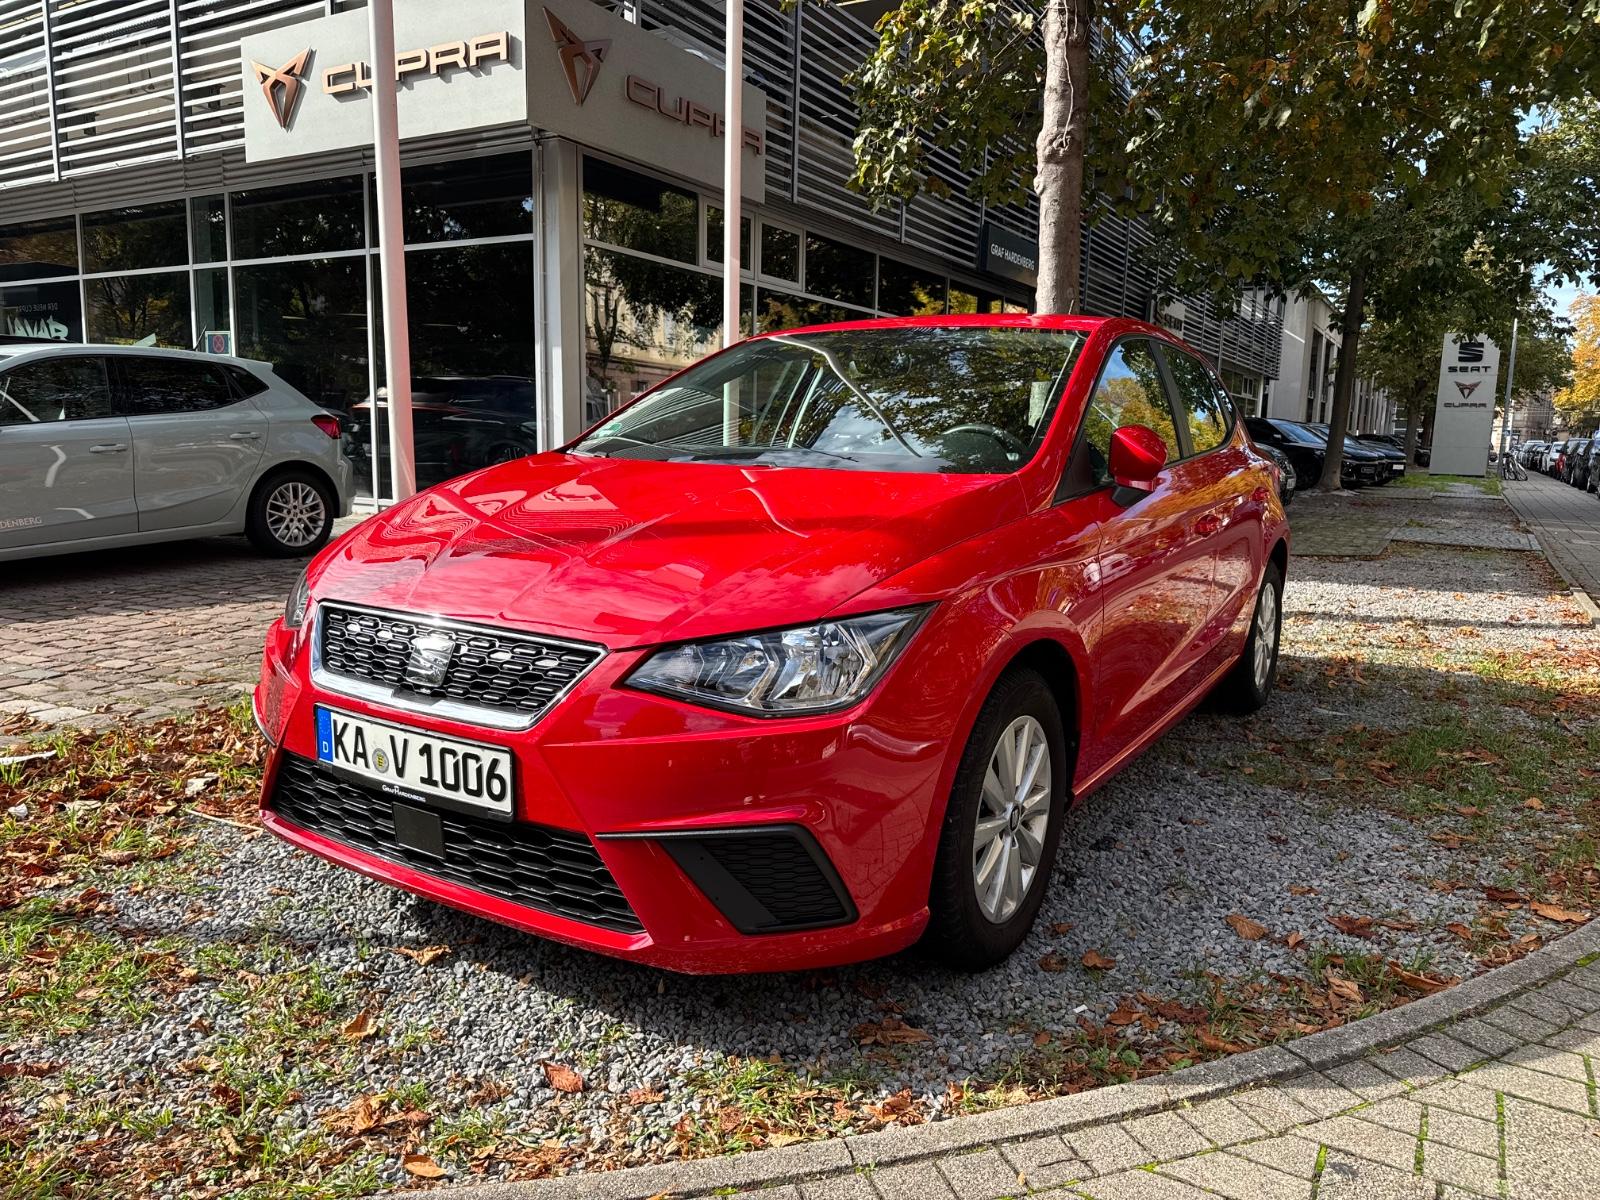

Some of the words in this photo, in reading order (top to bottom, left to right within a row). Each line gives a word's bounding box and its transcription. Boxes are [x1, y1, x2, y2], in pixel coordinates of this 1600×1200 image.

[990, 243, 1004, 258] GRAF
[1004, 249, 1035, 270] HARDENBERG
[1447, 365, 1492, 373] SEAT
[322, 741, 329, 753] D
[333, 718, 371, 769] KA
[389, 734, 409, 779] V
[418, 742, 508, 803] 1006
